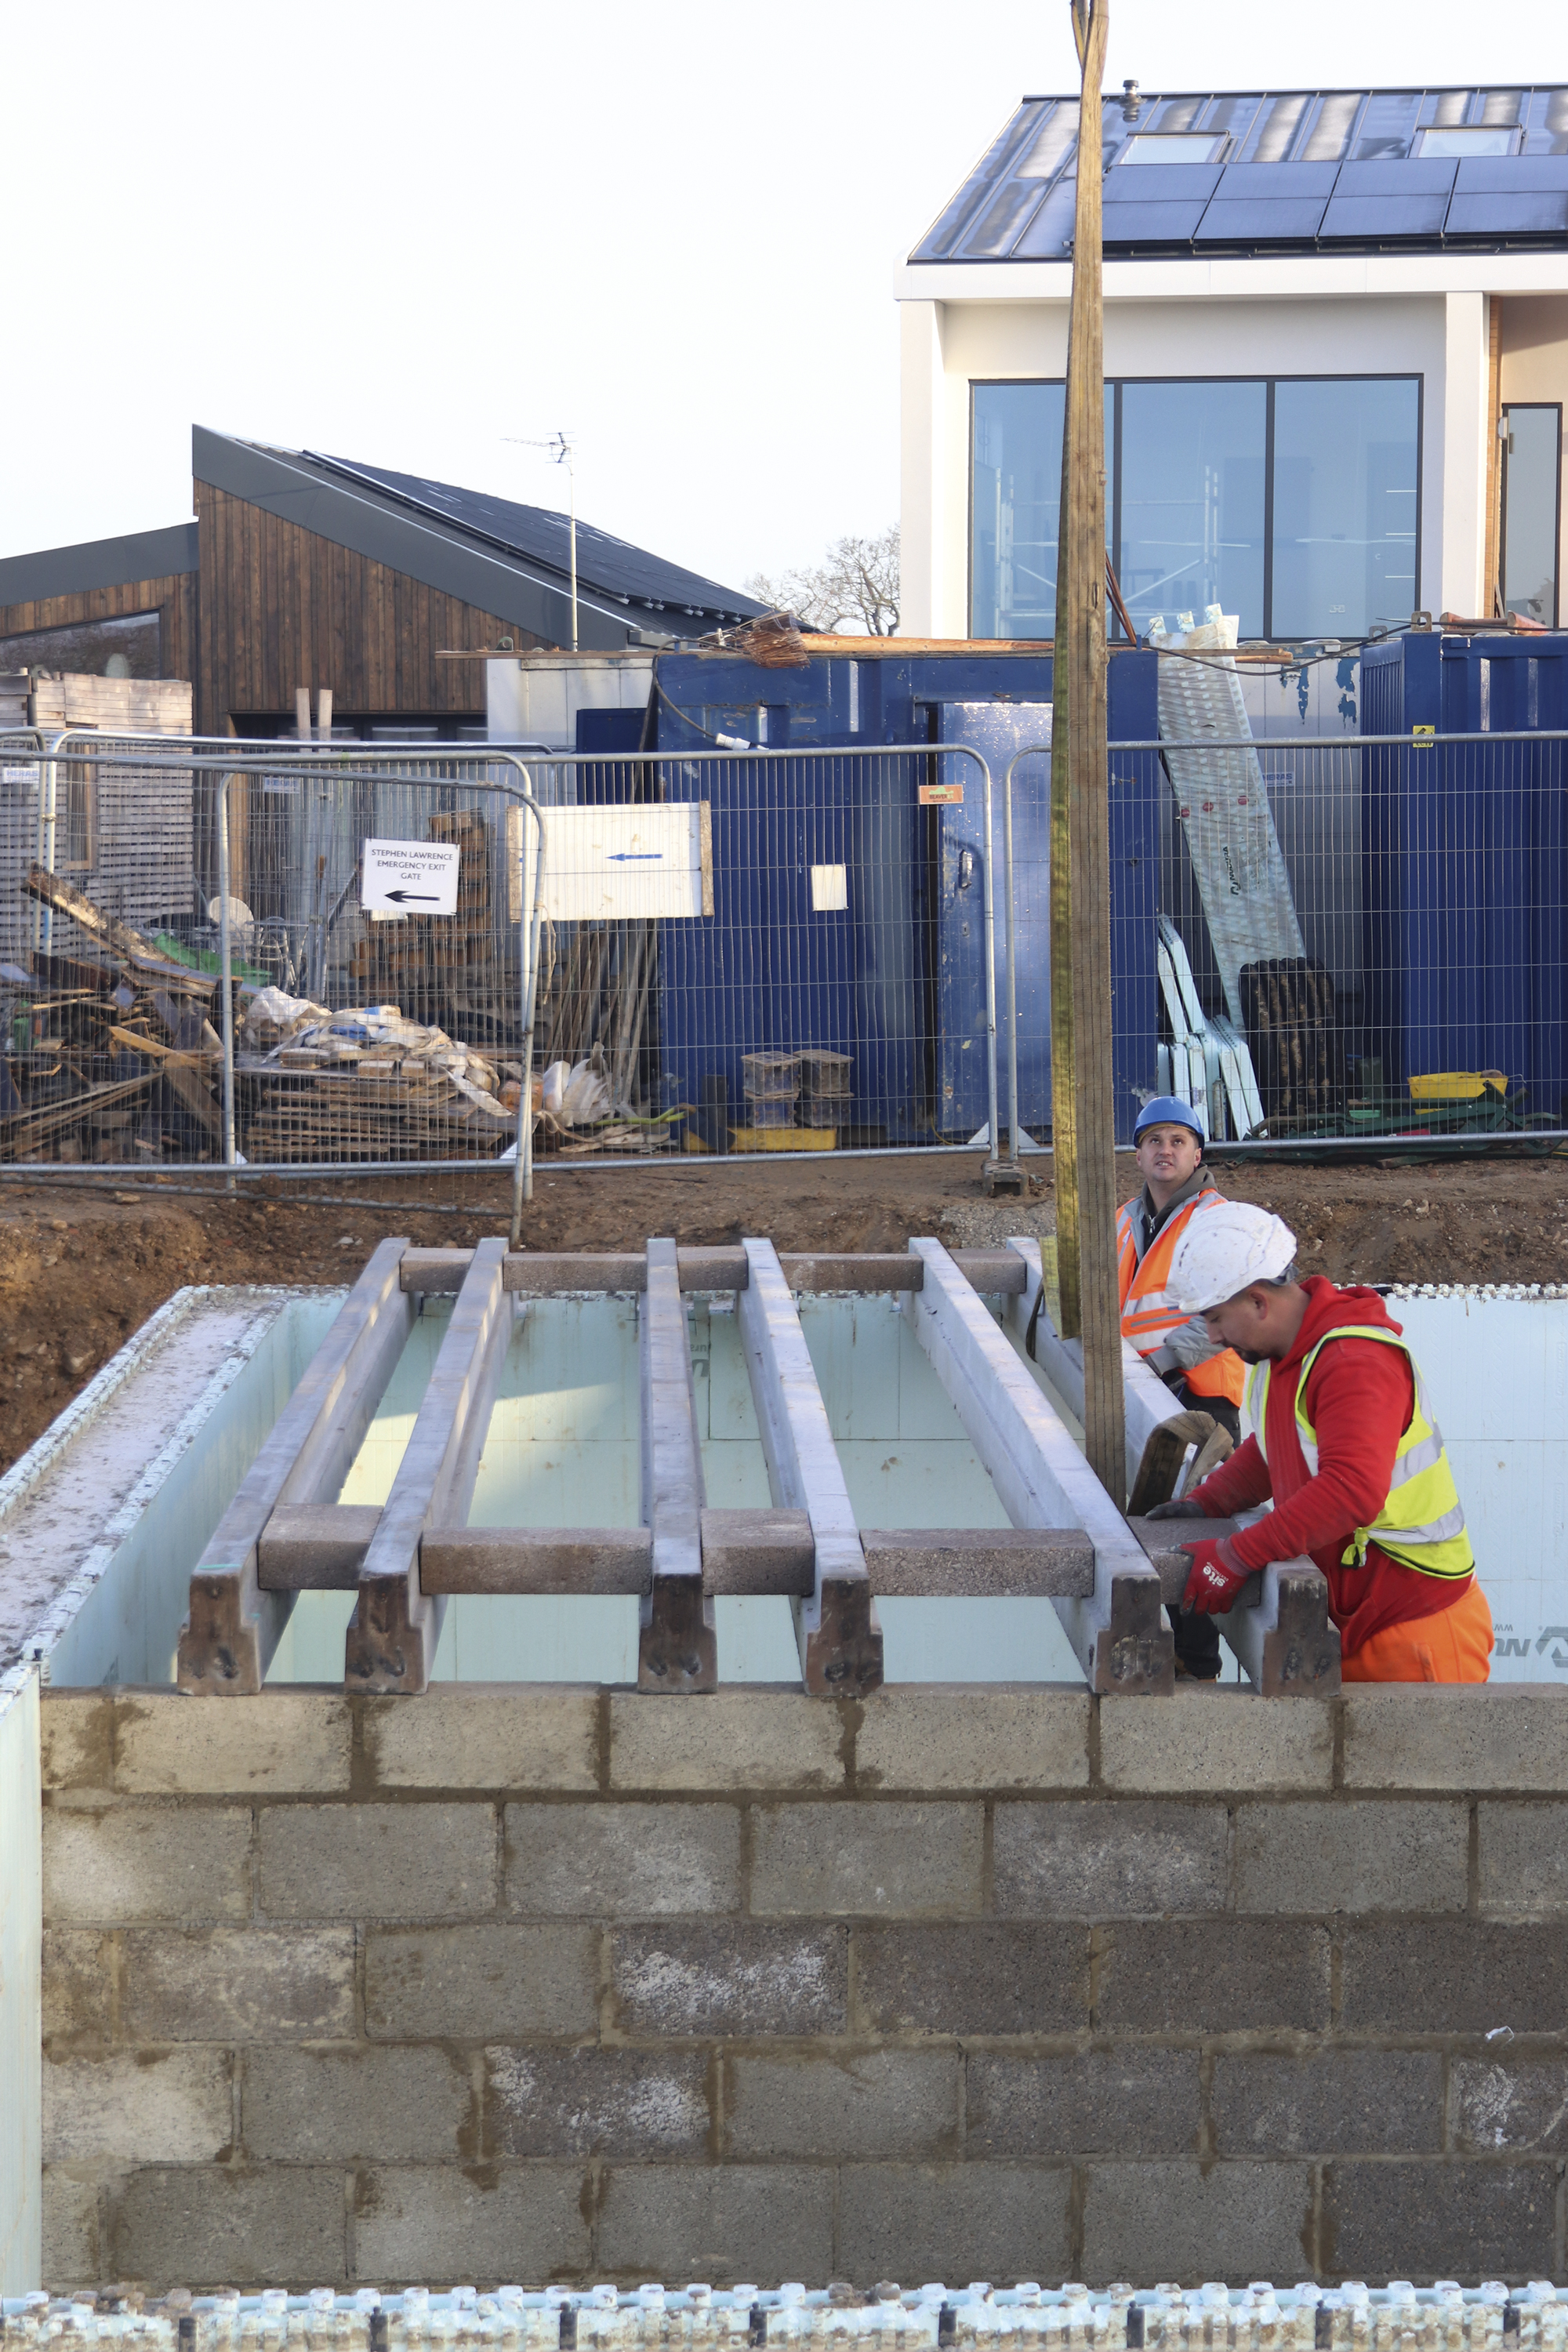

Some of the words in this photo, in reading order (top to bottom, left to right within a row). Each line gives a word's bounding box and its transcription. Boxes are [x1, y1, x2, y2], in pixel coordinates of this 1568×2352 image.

[372, 848, 408, 858] STEPHEN
[409, 851, 453, 861] LAWRENCE
[377, 860, 426, 869] EMERGENCY
[1203, 1565, 1225, 1587] site
